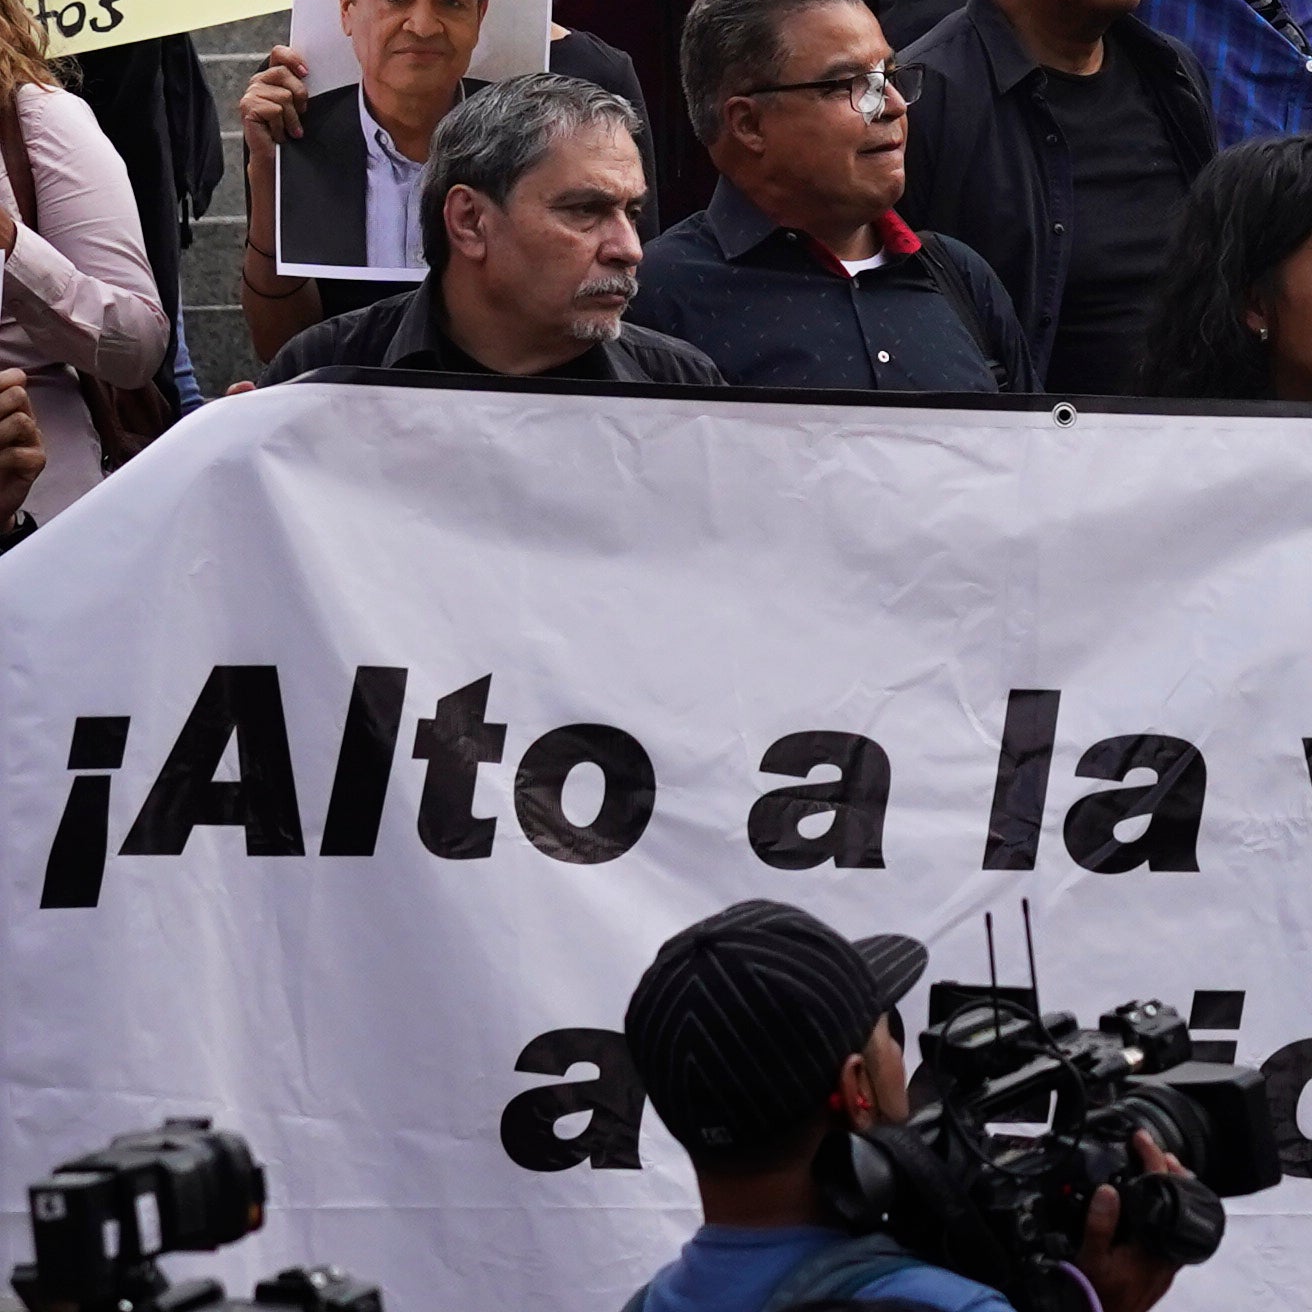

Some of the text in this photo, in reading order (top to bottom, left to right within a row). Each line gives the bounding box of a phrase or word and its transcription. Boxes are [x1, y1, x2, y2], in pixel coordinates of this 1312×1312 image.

[39, 663, 656, 910] ¡Alto
[746, 730, 892, 870] a
[981, 688, 1208, 874] la
[499, 1027, 647, 1173] a
